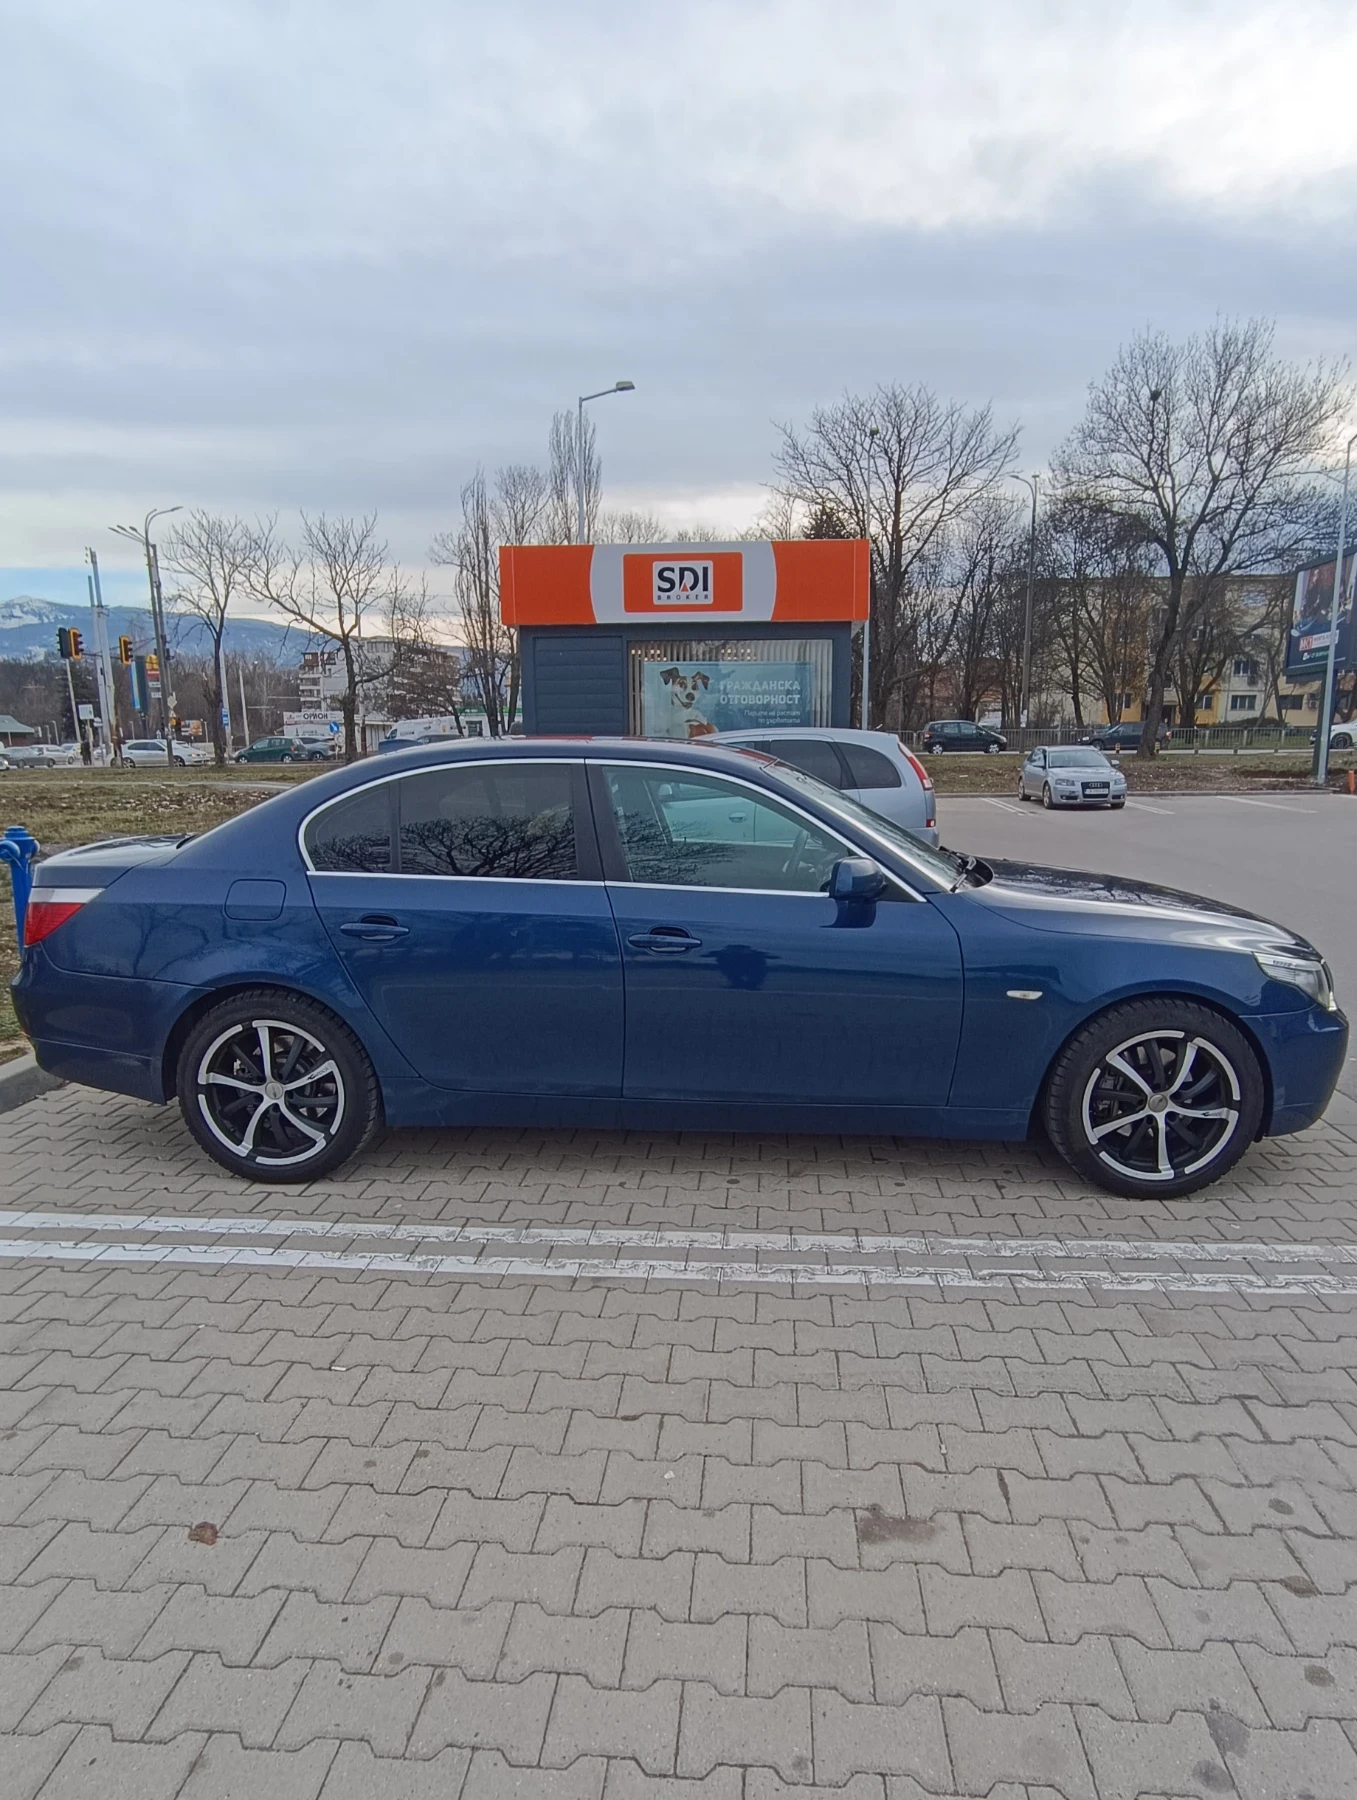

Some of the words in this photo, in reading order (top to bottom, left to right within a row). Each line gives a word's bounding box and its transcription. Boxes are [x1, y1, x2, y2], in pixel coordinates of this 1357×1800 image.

[657, 566, 709, 593] SDI
[719, 680, 801, 692] ГРАЖДАНСКА
[719, 694, 801, 705] ОТГОВОРНОСТ
